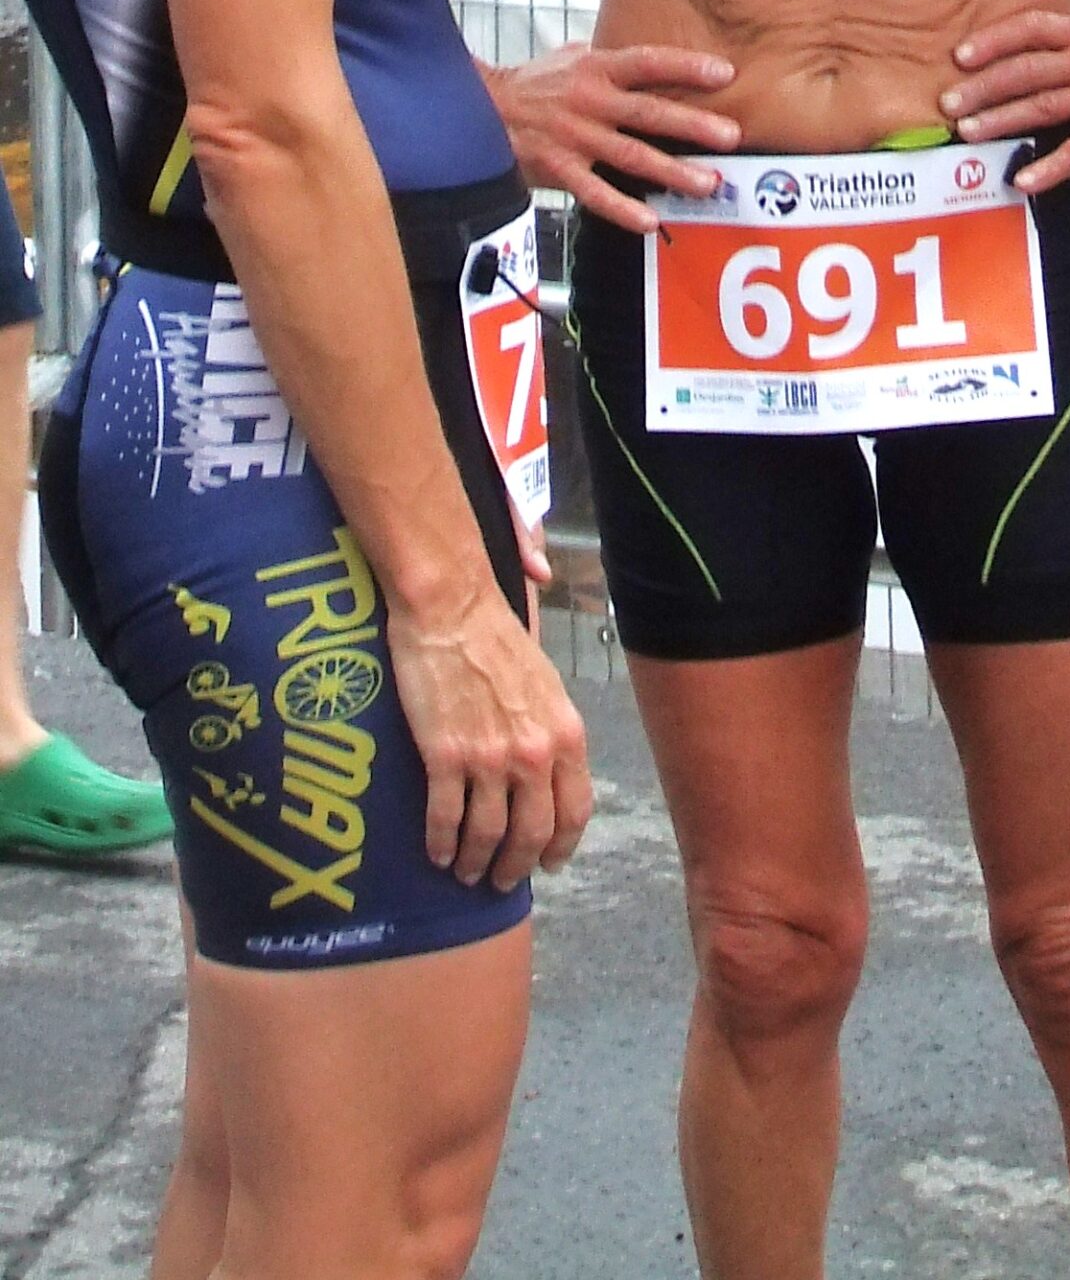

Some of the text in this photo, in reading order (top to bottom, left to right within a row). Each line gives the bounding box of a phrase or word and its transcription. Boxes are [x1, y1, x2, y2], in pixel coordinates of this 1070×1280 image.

[805, 170, 915, 195] Triathlon
[810, 191, 916, 212] VALLEYFIELD
[718, 235, 967, 361] 691
